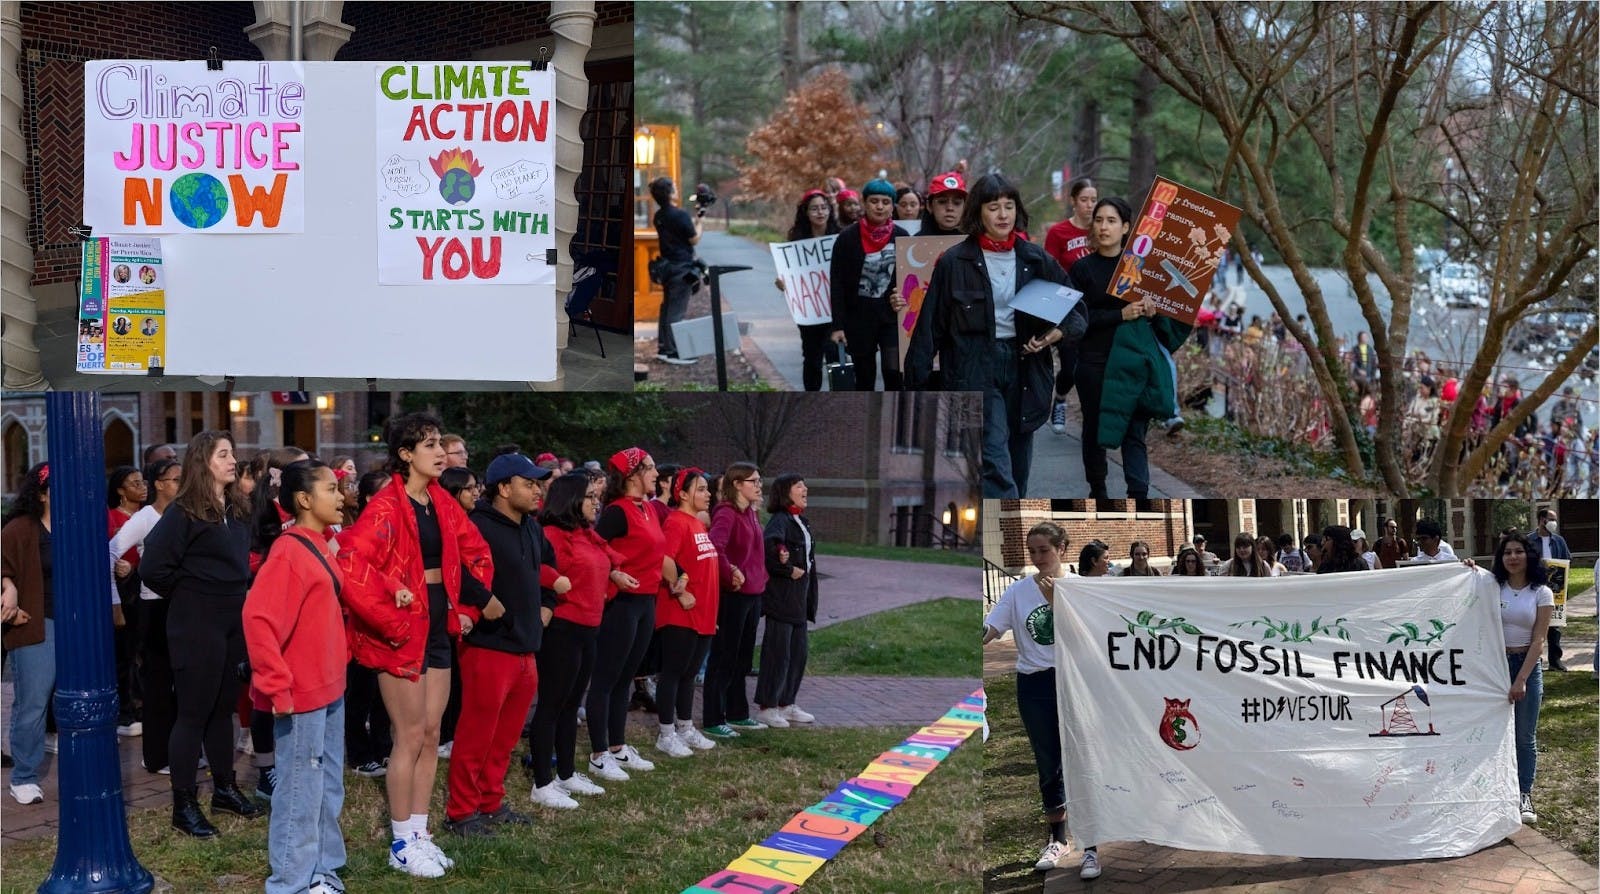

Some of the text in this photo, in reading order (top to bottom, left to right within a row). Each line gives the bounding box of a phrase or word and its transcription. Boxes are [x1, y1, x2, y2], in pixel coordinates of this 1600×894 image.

[96, 63, 304, 120] Climate
[380, 65, 531, 100] CLIMATE
[403, 100, 549, 142] ACTION
[113, 122, 301, 171] JUSTICE
[389, 207, 549, 234] STARTS WITH
[416, 236, 503, 280] YOU
[777, 238, 833, 269] TIME
[781, 270, 832, 318] WARN
[1107, 631, 1467, 686] END FOSSIL FINANCE
